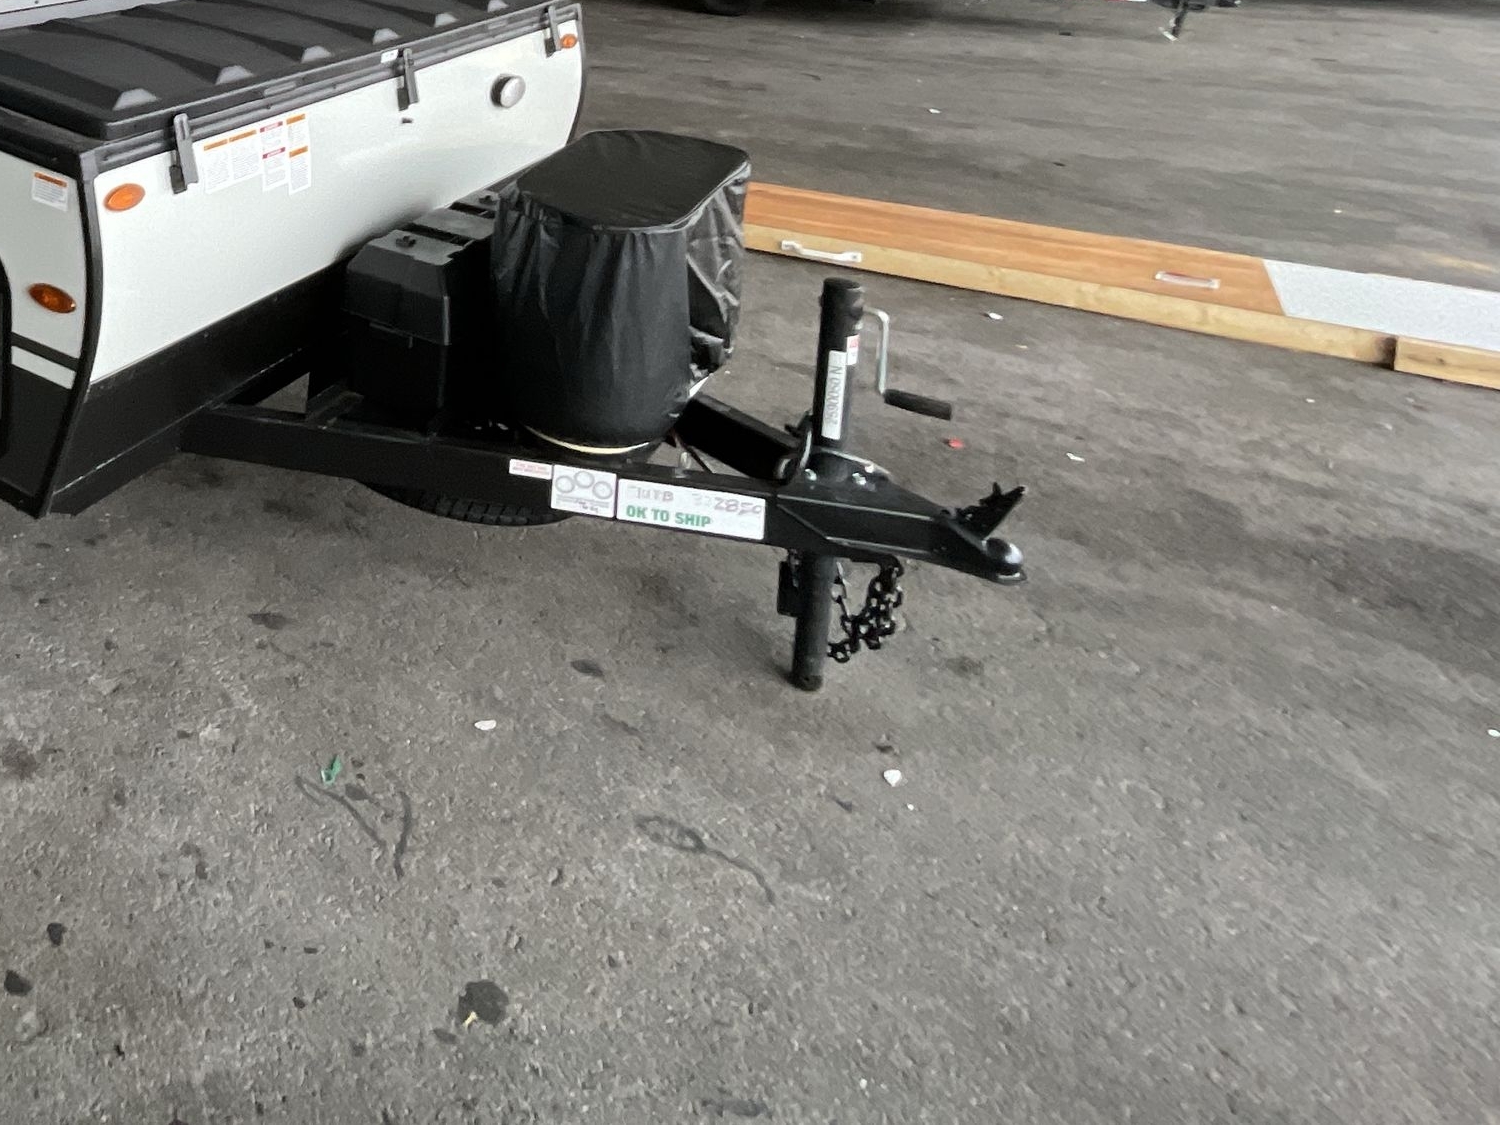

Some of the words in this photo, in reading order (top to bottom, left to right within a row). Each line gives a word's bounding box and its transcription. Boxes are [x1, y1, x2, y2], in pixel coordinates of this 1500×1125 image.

[626, 505, 648, 518] OK
[651, 509, 670, 522] TO
[675, 512, 712, 527] SHIP
